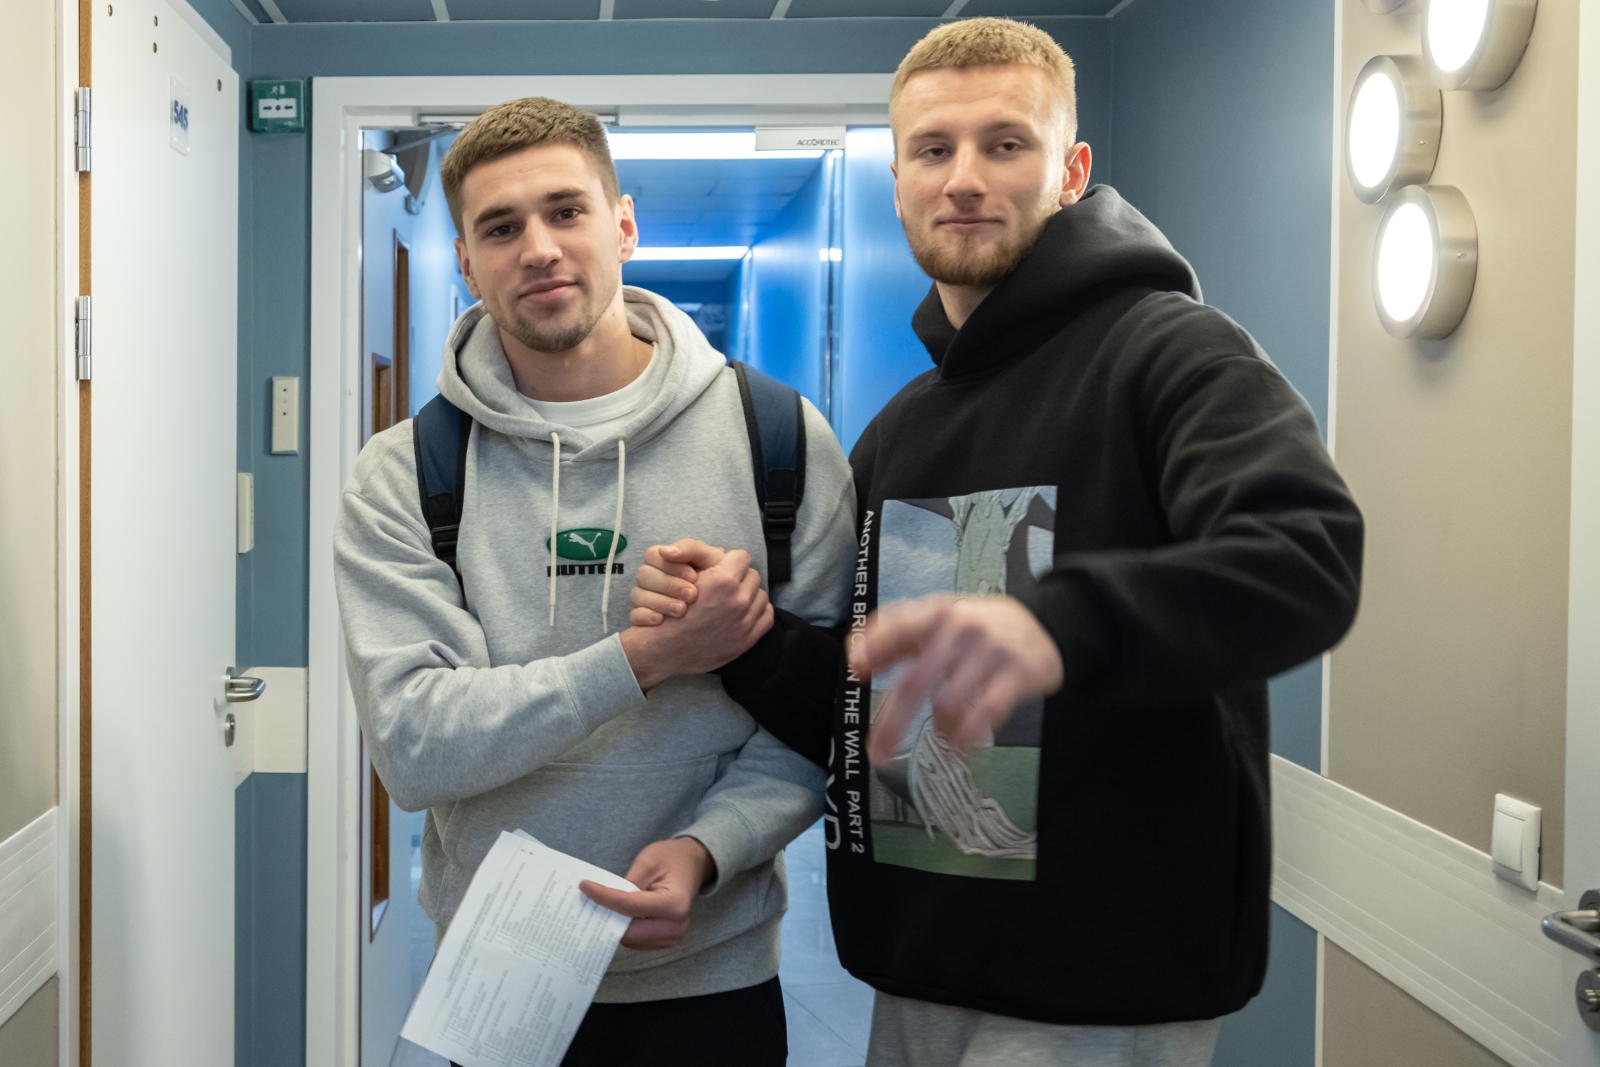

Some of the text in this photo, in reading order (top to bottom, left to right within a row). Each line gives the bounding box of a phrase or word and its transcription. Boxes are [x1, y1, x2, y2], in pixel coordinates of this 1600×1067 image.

[173, 99, 188, 132] 545
[797, 138, 839, 146] ACCORDTEC
[854, 510, 874, 597] ANOTHER
[849, 602, 867, 657] BRIC
[844, 687, 860, 724] THE
[844, 730, 860, 779] WALL
[846, 790, 863, 839] PART
[851, 842, 865, 853] 2
